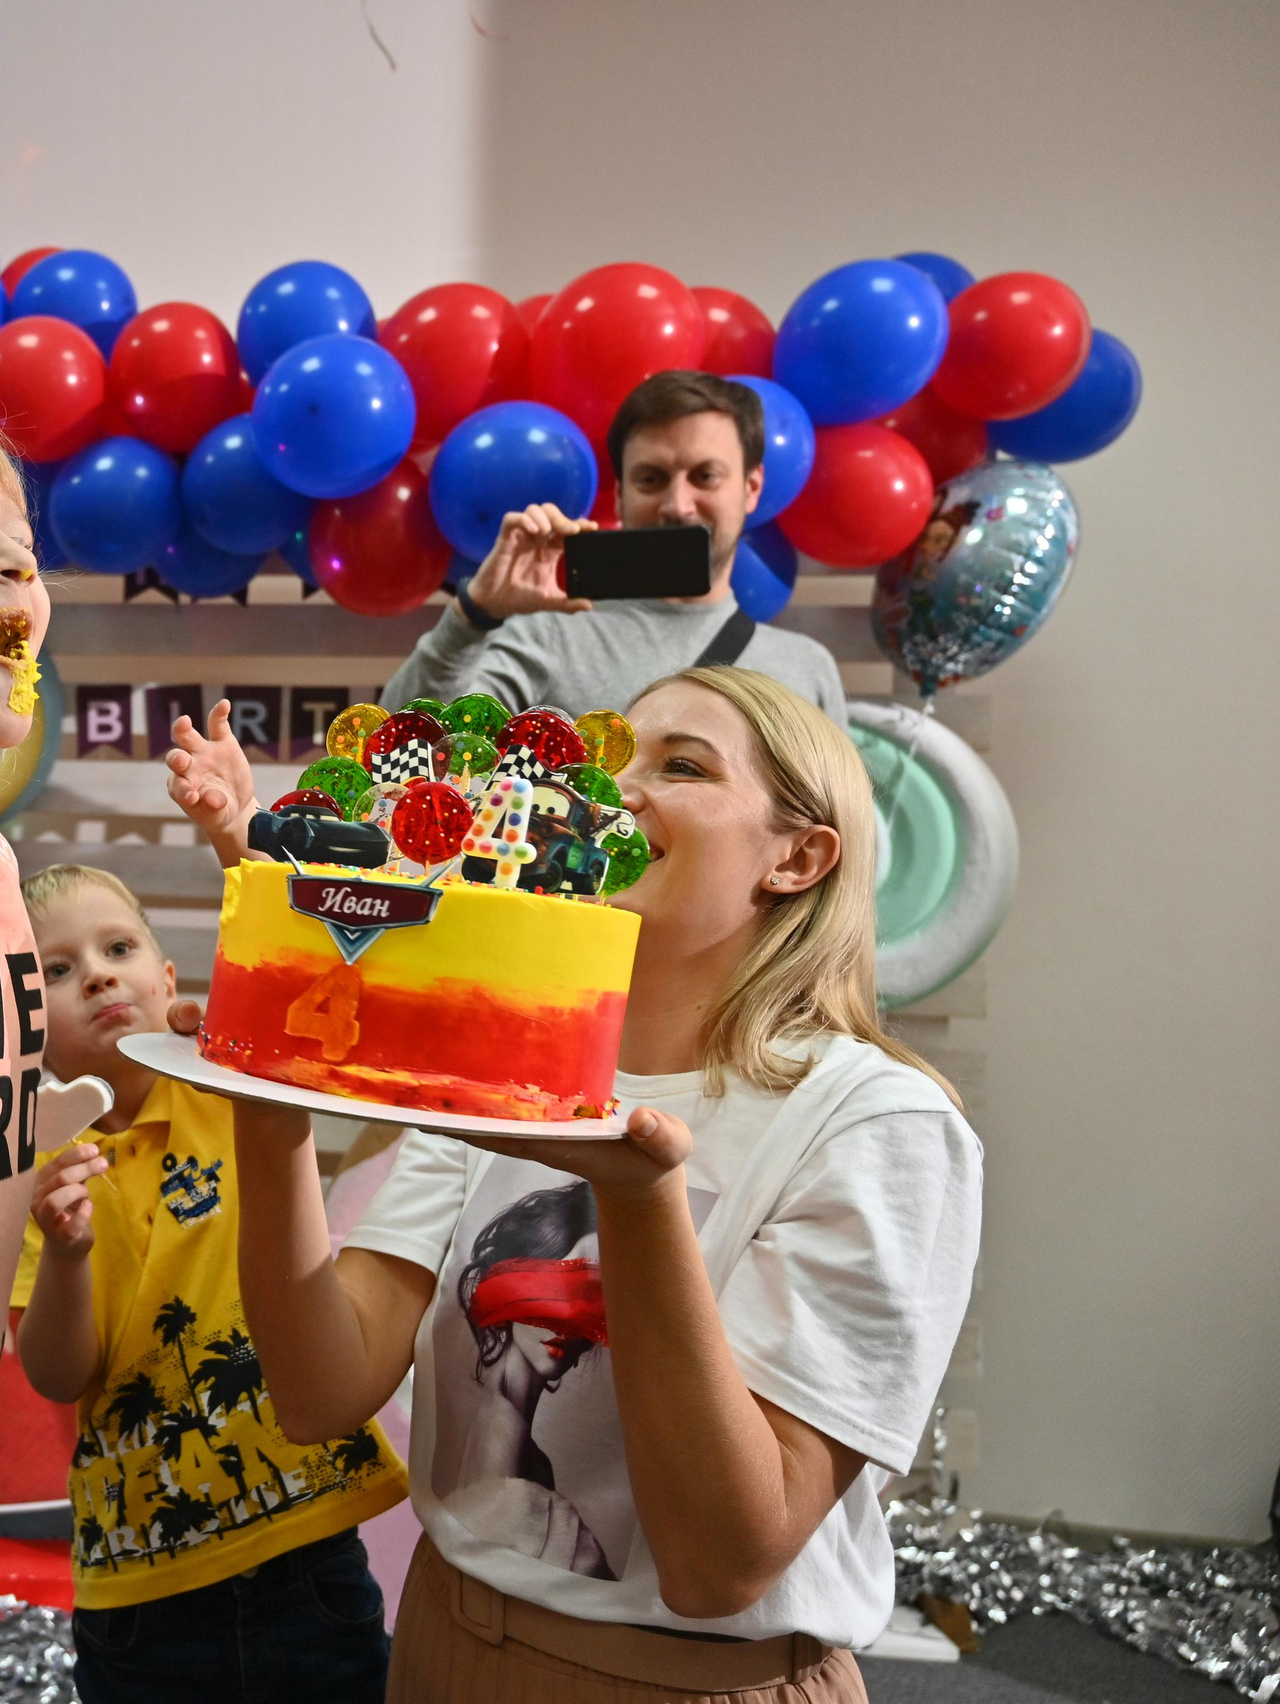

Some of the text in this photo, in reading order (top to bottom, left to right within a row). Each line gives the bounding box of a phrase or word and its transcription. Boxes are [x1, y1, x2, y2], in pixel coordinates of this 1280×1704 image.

[461, 776, 538, 888] 4
[318, 886, 391, 918] Иван
[285, 963, 364, 1062] 4
